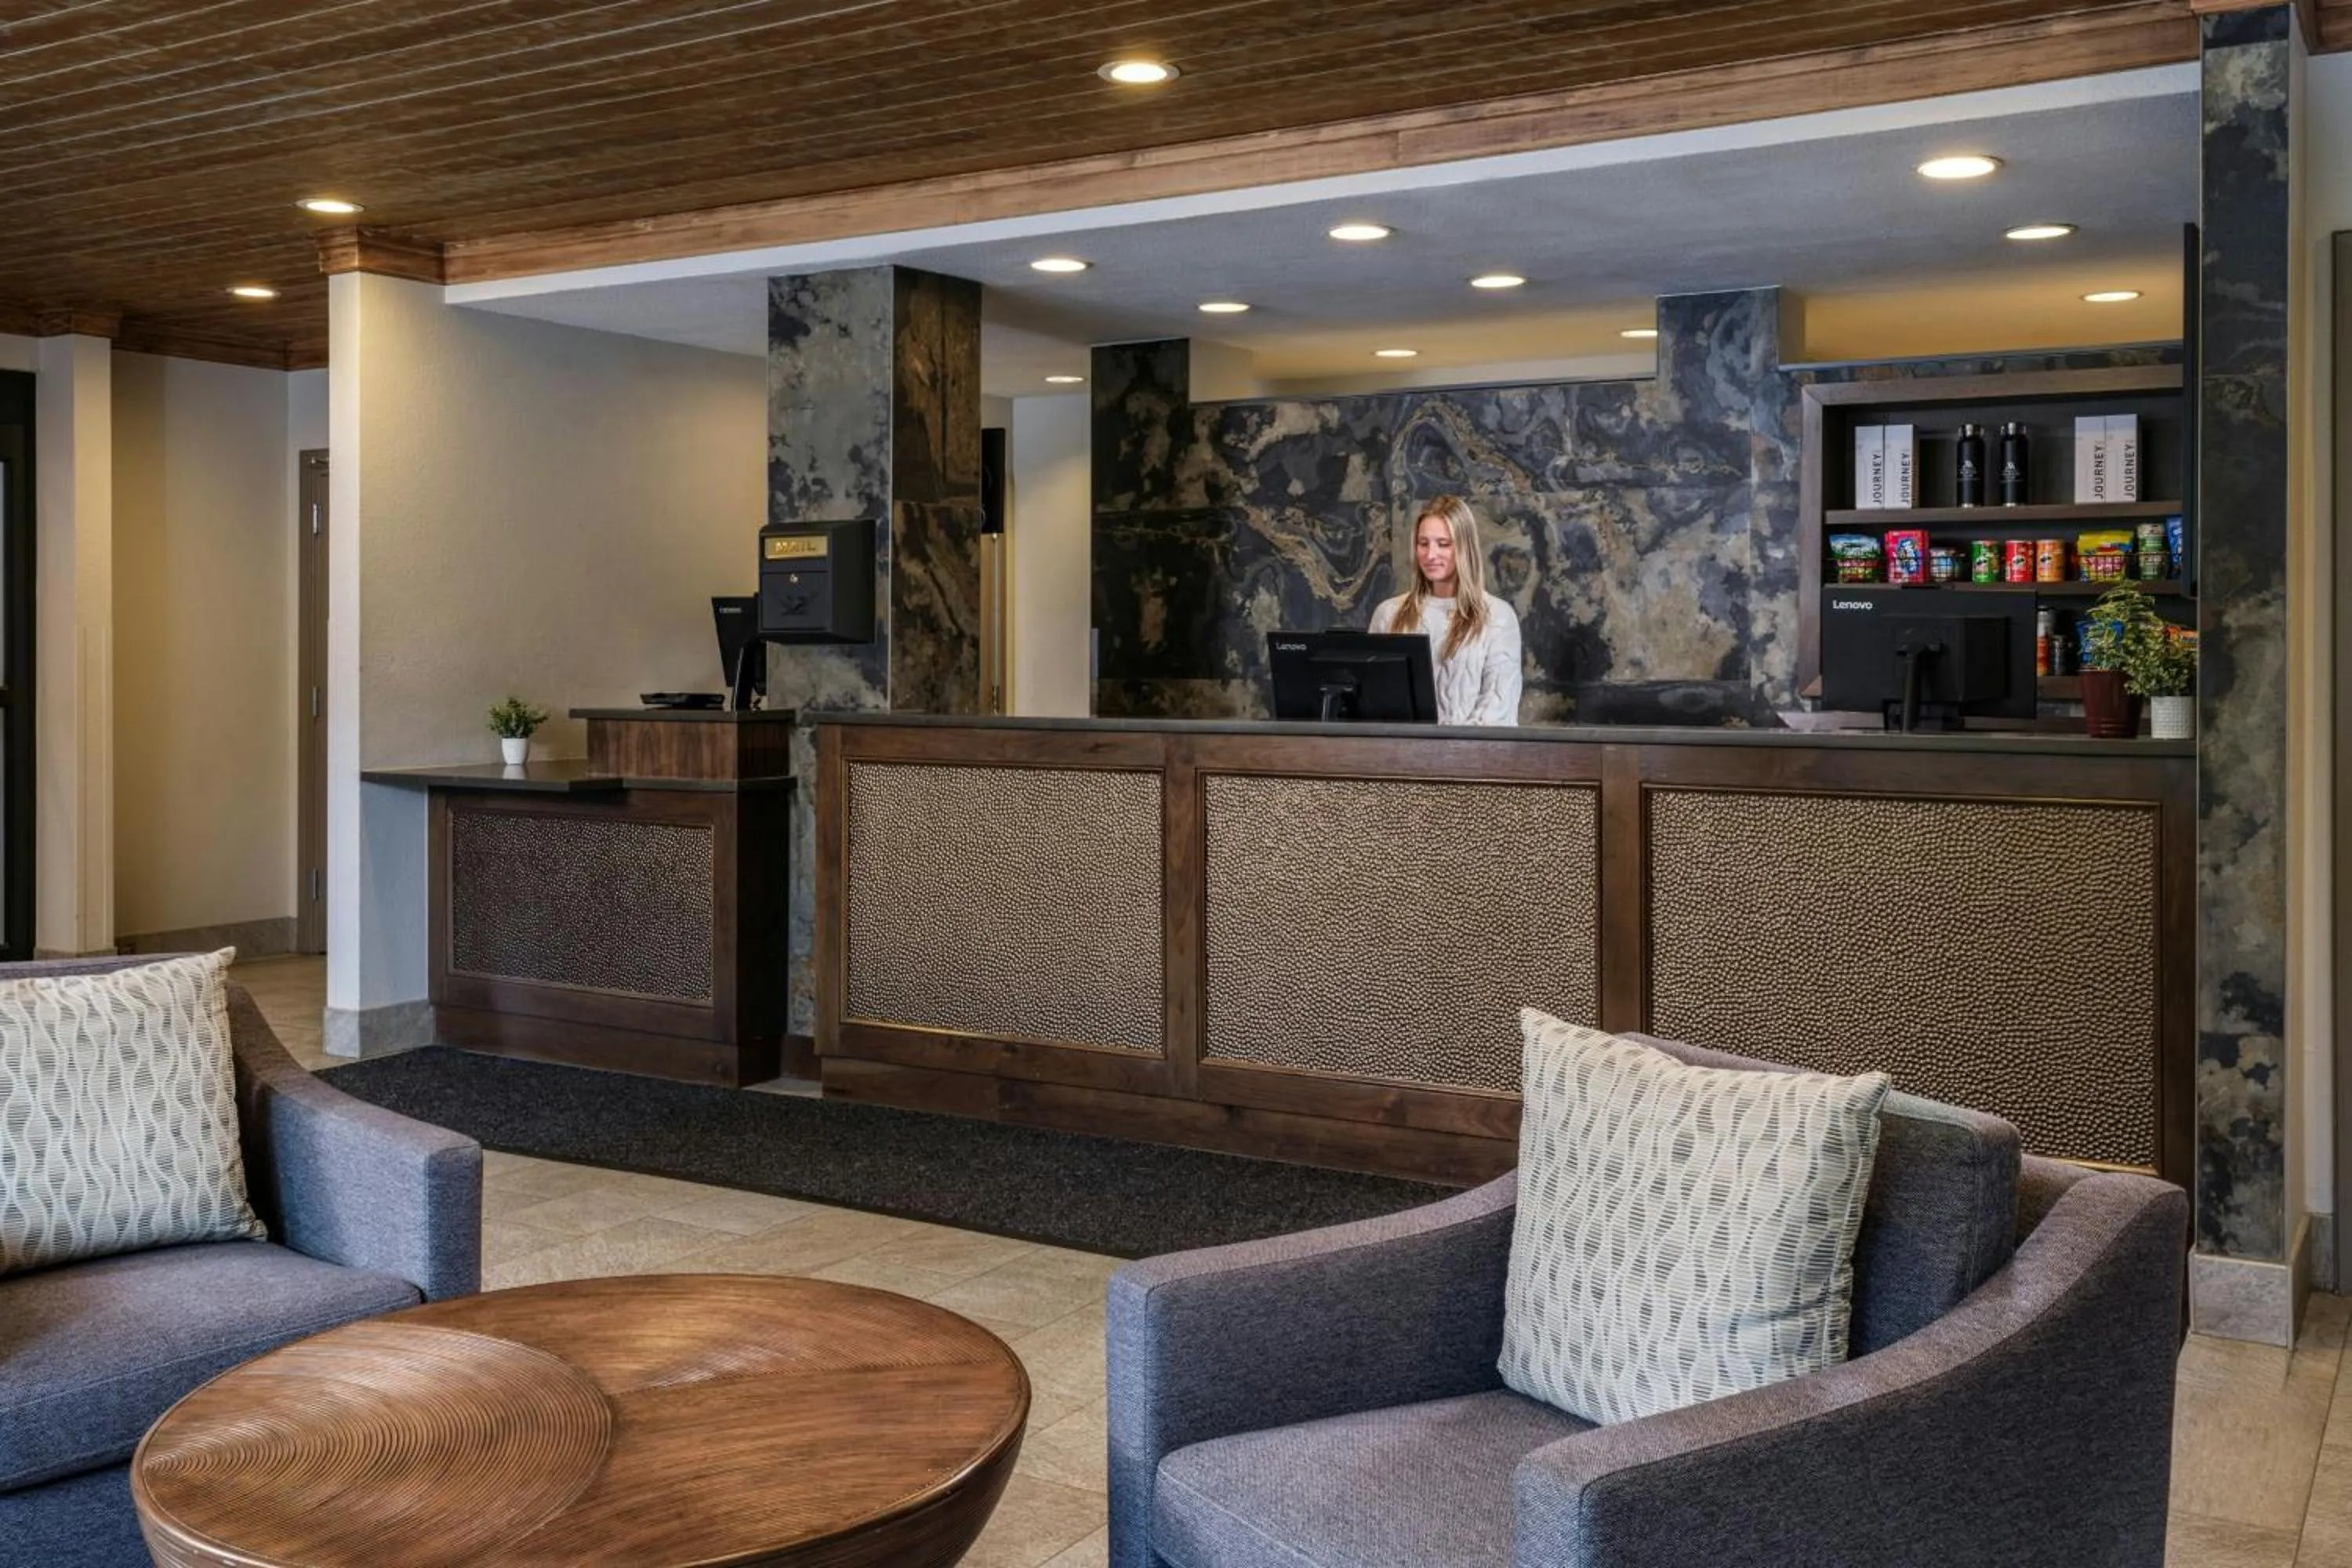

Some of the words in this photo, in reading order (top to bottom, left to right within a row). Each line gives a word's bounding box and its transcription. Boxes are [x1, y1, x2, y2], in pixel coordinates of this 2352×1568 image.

[1871, 453, 1882, 504] JOURNEY
[2093, 445, 2103, 499] JOURNEY
[2124, 444, 2135, 499] JOURNEY
[1832, 599, 1874, 610] Lenovo
